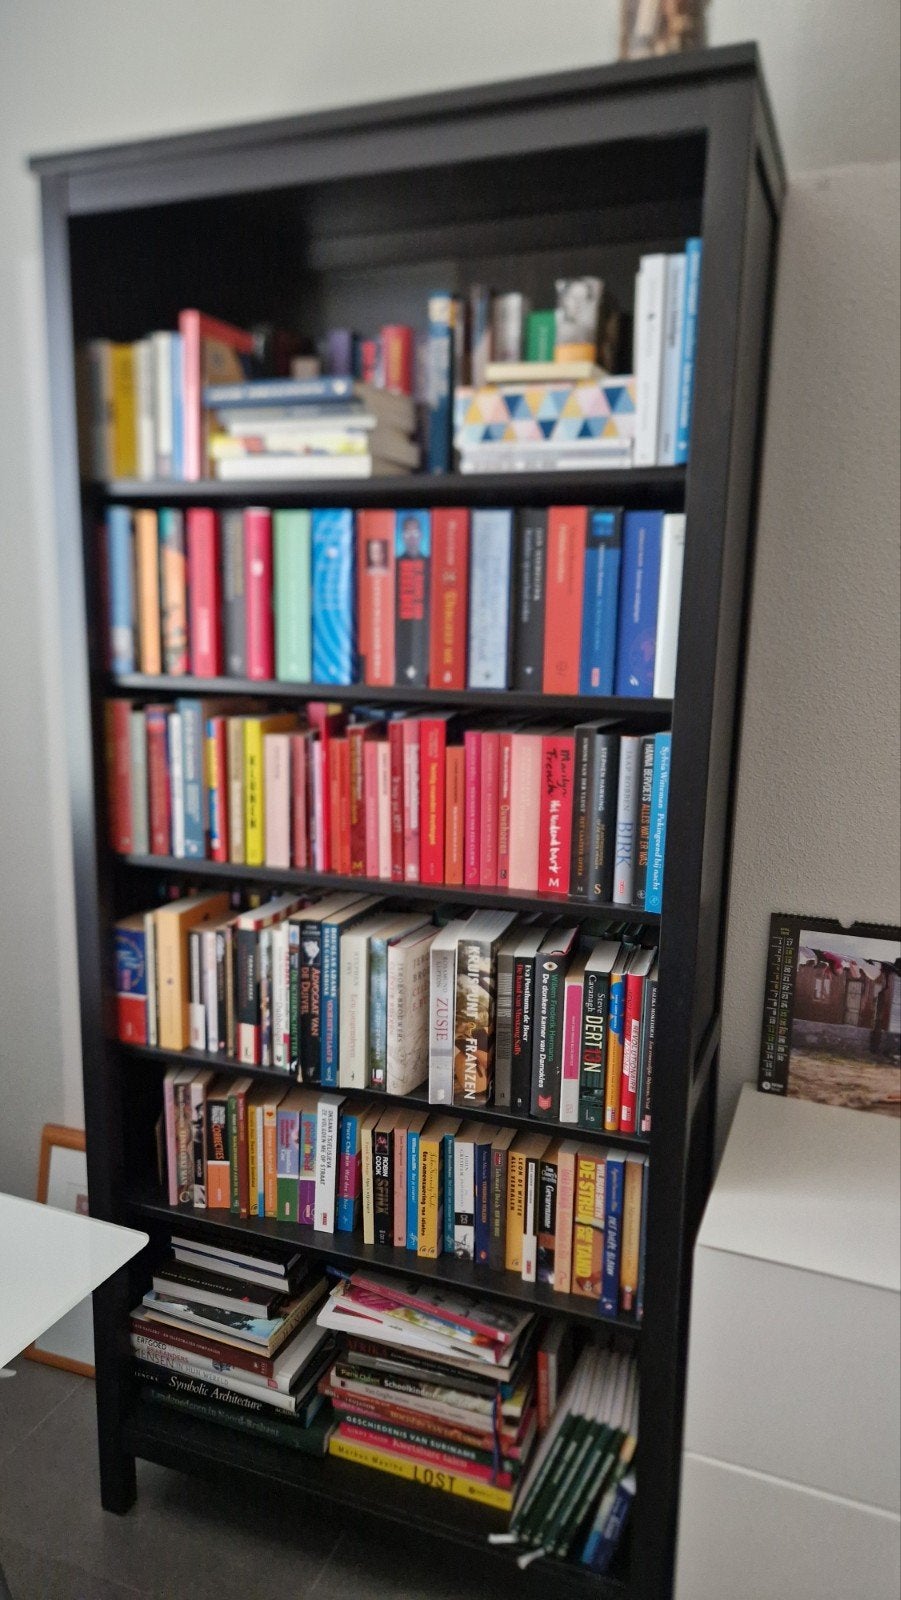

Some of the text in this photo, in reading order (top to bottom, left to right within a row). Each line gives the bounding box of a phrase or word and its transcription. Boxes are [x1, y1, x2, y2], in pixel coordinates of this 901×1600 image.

[545, 748, 557, 795] French
[599, 747, 607, 781] STEPHEN
[659, 746, 669, 770] Sylvia
[639, 744, 653, 866] HANNA BERVOETS ALLES WAT ER WAS
[658, 772, 668, 808] Witteman
[616, 821, 633, 869] BIRK
[652, 869, 661, 890] nacht
[653, 858, 662, 868] bij
[516, 964, 523, 975] De
[542, 973, 549, 984] De
[301, 967, 309, 1014] DE DUIVEL
[311, 968, 320, 1036] ADVOCAAT VAN
[523, 979, 531, 1013] Posthuma
[586, 975, 596, 1012] Cavanagh
[597, 993, 606, 1014] Steve
[434, 998, 449, 1041] ZUSJE
[463, 946, 480, 1100] KRUISPUNT FRANZEN
[524, 1015, 530, 1024] de
[540, 1016, 548, 1038] kamer
[548, 974, 558, 1062] Willem Frederik Hermans
[538, 1054, 546, 1088] Damokles
[629, 1025, 638, 1091] REVOLUTIONAIRE
[213, 1124, 224, 1159] CORRECTIES
[321, 1145, 326, 1153] ME
[518, 1179, 522, 1187] DE
[579, 1161, 595, 1179] DE
[544, 1185, 554, 1229] Gevarenzone
[595, 1164, 605, 1218] WILBUR SMITH
[576, 1244, 592, 1278] TAND
[169, 1376, 262, 1411] Symbolic Architecture
[203, 1370, 229, 1386] WERELD
[346, 1415, 408, 1439] GESCHIEDENIS
[410, 1434, 428, 1445] VAN
[430, 1438, 476, 1460] SURINAME
[414, 1465, 456, 1492] LOST
